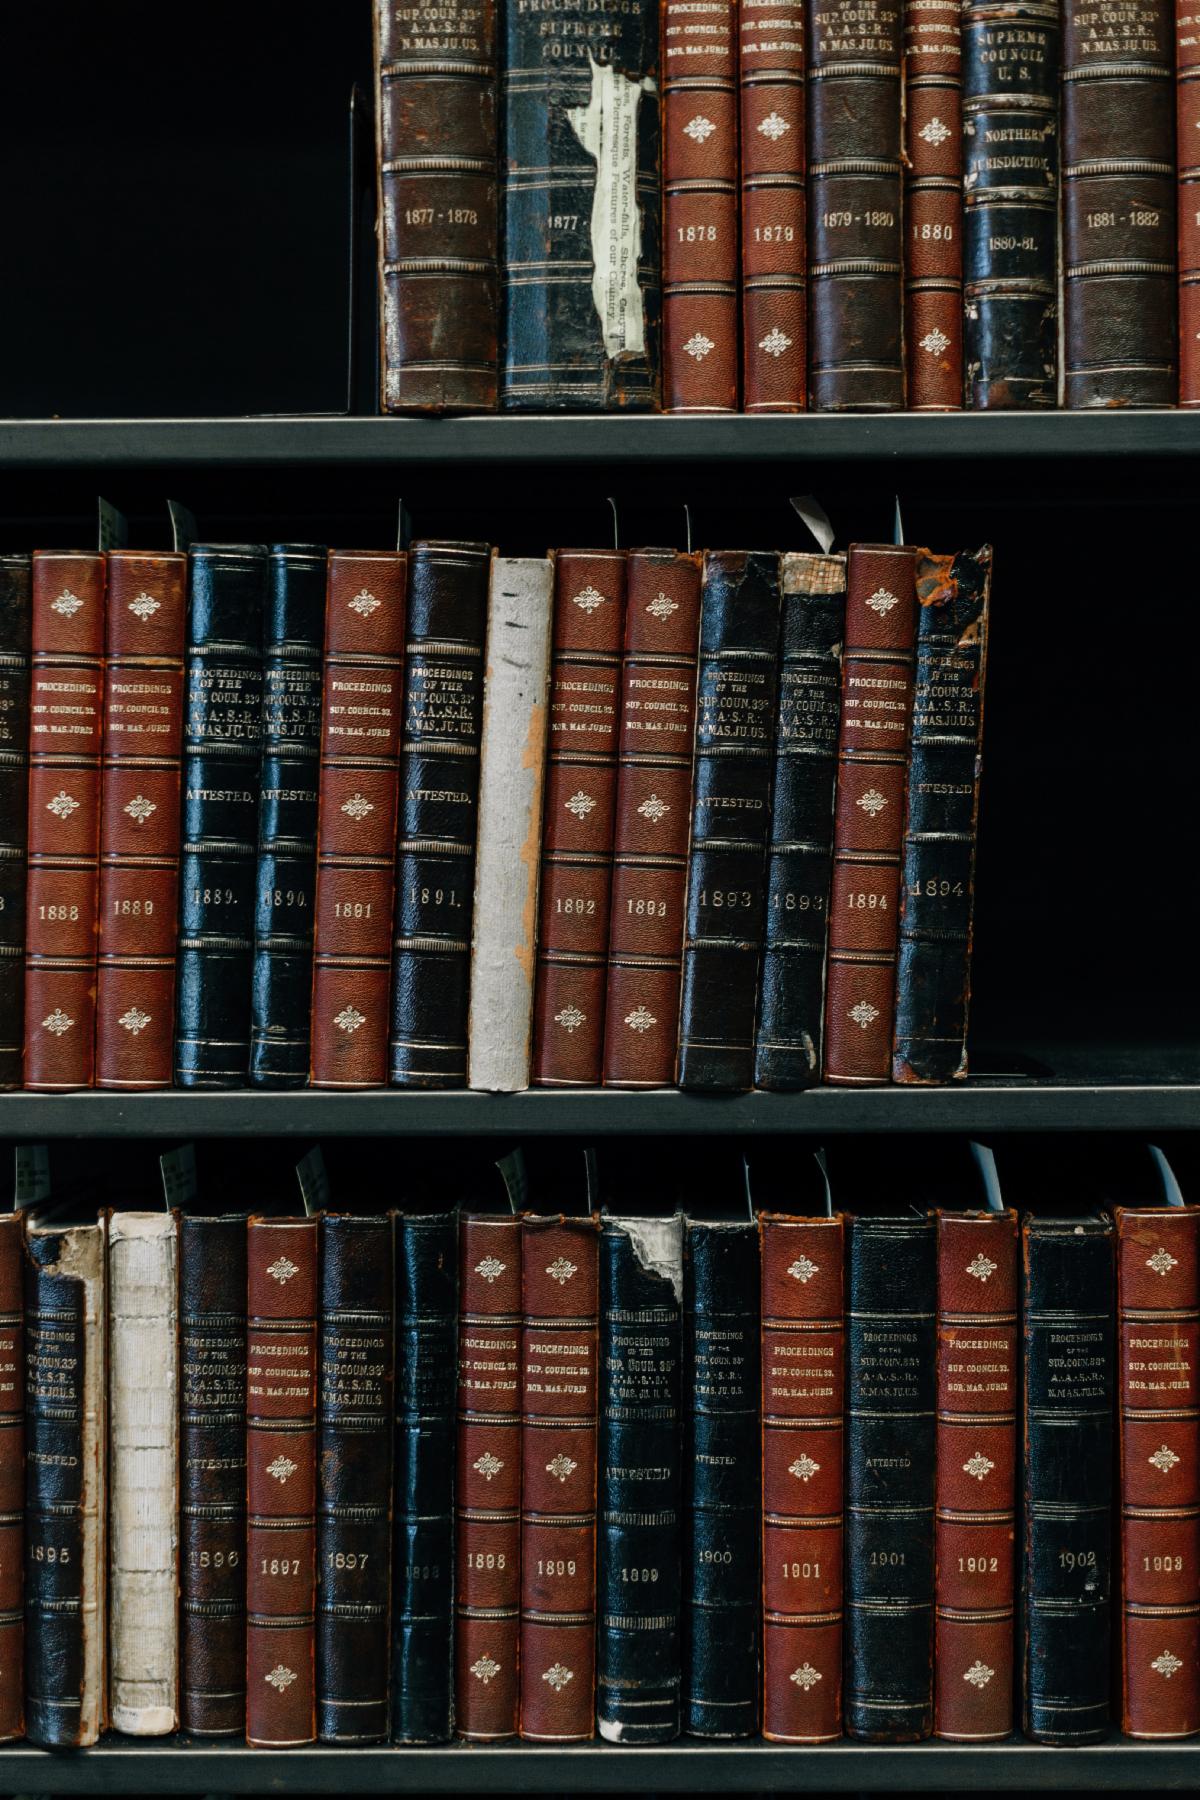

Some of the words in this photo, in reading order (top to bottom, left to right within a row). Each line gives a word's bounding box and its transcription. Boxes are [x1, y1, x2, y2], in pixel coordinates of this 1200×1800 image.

[977, 30, 1047, 46] SUPREME
[980, 48, 1044, 63] COUNCIL
[610, 97, 621, 167] Picturesque
[985, 128, 1045, 142] NORTHERN
[405, 209, 434, 225] 1877
[448, 209, 477, 225] 1878
[823, 212, 852, 227] 1879
[864, 211, 894, 227] 1880
[1087, 213, 1116, 228] 1881
[1129, 213, 1159, 227] 1882
[677, 226, 717, 242] 1878
[754, 226, 794, 242] 1879
[913, 225, 953, 241] 1880
[412, 668, 473, 680] PROCEEDINGS
[37, 682, 96, 694] PROCEEDINGS
[112, 684, 172, 694] PROCEEDINGS
[218, 680, 242, 688] THE
[288, 683, 311, 691] THE
[333, 682, 392, 693] PROCEEDINGS
[441, 682, 463, 691] THE
[555, 682, 614, 693] PROCEEDINGS
[629, 680, 689, 690] PROCEEDINGS
[849, 678, 907, 689] PROCEEDINGS
[51, 706, 82, 715] COUNCIL
[126, 705, 159, 714] COUNCIL
[348, 707, 380, 715] COUNCIL
[569, 704, 601, 713] COUNCIL
[644, 702, 678, 711] COUNCIL
[863, 700, 897, 709] COUNCIL
[911, 880, 964, 897] 1894
[556, 898, 595, 914] 1892
[699, 891, 752, 907] 1893
[772, 893, 824, 910] 1893
[847, 893, 888, 910] 1894
[38, 905, 79, 921] 1888
[113, 900, 153, 915] 1889
[334, 903, 372, 918] 1891
[627, 900, 666, 916] 1893
[323, 1336, 384, 1347] PROCEEDINGS
[949, 1340, 1009, 1349] PROCEEDINGS
[1129, 1339, 1189, 1348] PROCEEDINGS
[250, 1345, 309, 1356] PROCEEDINGS
[351, 1352, 367, 1360] THE
[530, 1344, 589, 1355] PROCEEDINGS
[774, 1346, 834, 1356] PROCEEDINGS
[265, 1368, 299, 1377] COUNCIL
[473, 1361, 506, 1371] COUNCIL
[545, 1366, 578, 1375] COUNCIL
[791, 1368, 823, 1376] COUNCIL
[966, 1364, 998, 1373] COUNCIL
[1148, 1362, 1181, 1371] COUNCIL
[31, 1544, 70, 1563] 1895
[188, 1551, 239, 1568] 1896
[699, 1550, 732, 1564] 1900
[870, 1552, 906, 1567] 1901
[261, 1559, 300, 1575] 1897
[328, 1553, 369, 1569] 1897
[467, 1553, 506, 1569] 1898
[536, 1560, 577, 1575] 1899
[958, 1557, 999, 1573] 1902
[1058, 1551, 1097, 1572] 1902
[1143, 1556, 1183, 1571] 1903
[782, 1563, 821, 1579] 1901
